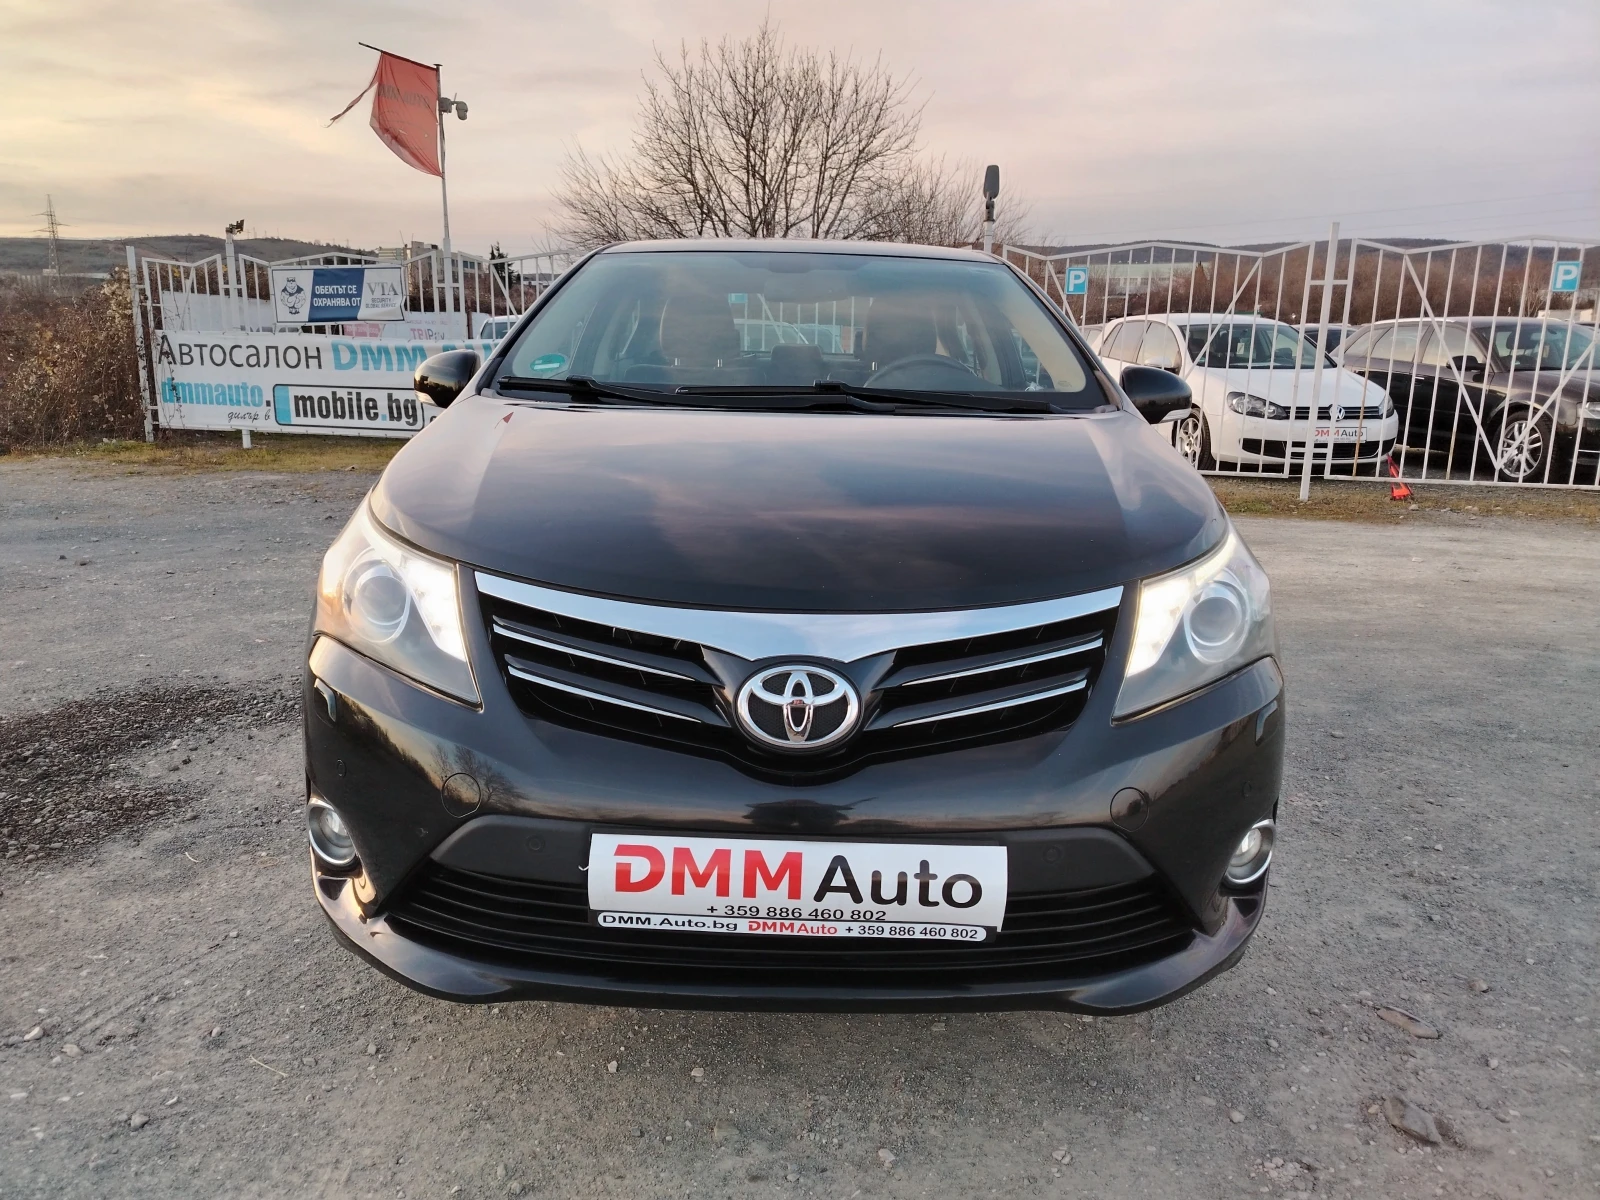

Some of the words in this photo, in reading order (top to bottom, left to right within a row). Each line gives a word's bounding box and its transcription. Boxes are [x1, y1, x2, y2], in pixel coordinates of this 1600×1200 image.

[366, 281, 399, 296] VTA
[1068, 270, 1086, 292] P
[1556, 265, 1578, 289] P
[315, 285, 347, 295] ОБЕКТЪТ
[347, 285, 357, 294] СЕ
[313, 297, 351, 307] ОХРАНЯВА
[352, 297, 361, 307] ОТ
[158, 334, 323, 370] Автосалон
[330, 339, 428, 372] DMM
[293, 390, 419, 426] mobile.bg
[724, 904, 760, 917] 359
[766, 906, 803, 919] 886
[807, 908, 844, 920] 460
[850, 909, 886, 921] 802
[602, 914, 738, 931] DMM.Auto.bg
[858, 925, 885, 936] 359
[888, 926, 916, 937] 886
[919, 927, 946, 938] 460
[950, 928, 978, 939] 802
